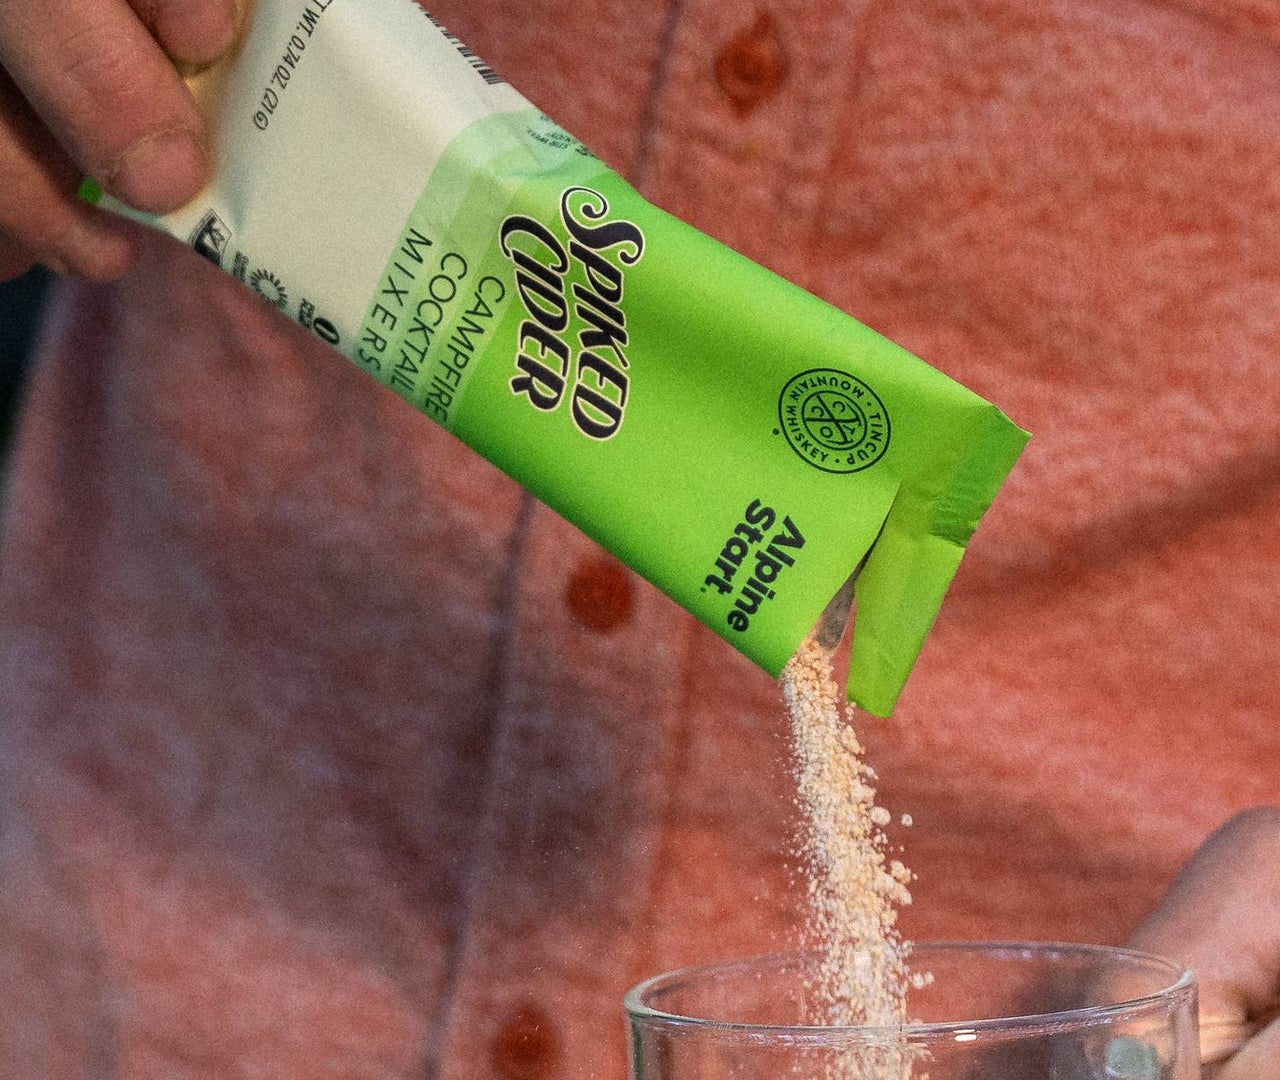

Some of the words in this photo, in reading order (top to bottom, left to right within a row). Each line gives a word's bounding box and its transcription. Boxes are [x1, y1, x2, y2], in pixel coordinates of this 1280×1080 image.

[282, 35, 306, 69] 0.74
[296, 7, 320, 37] WT.
[271, 65, 291, 90] OZ.
[358, 228, 433, 372] MIXERS
[391, 252, 468, 392] COCKTAIL
[499, 214, 570, 411] CIDER
[560, 187, 644, 441] SPIKED
[426, 276, 505, 422] CAMPFIRE
[789, 376, 865, 401] MOUNTAIN
[786, 405, 829, 462] WHISKEY
[846, 412, 883, 465] TINCUP
[704, 498, 776, 595] Start
[727, 515, 806, 632] Alpine
